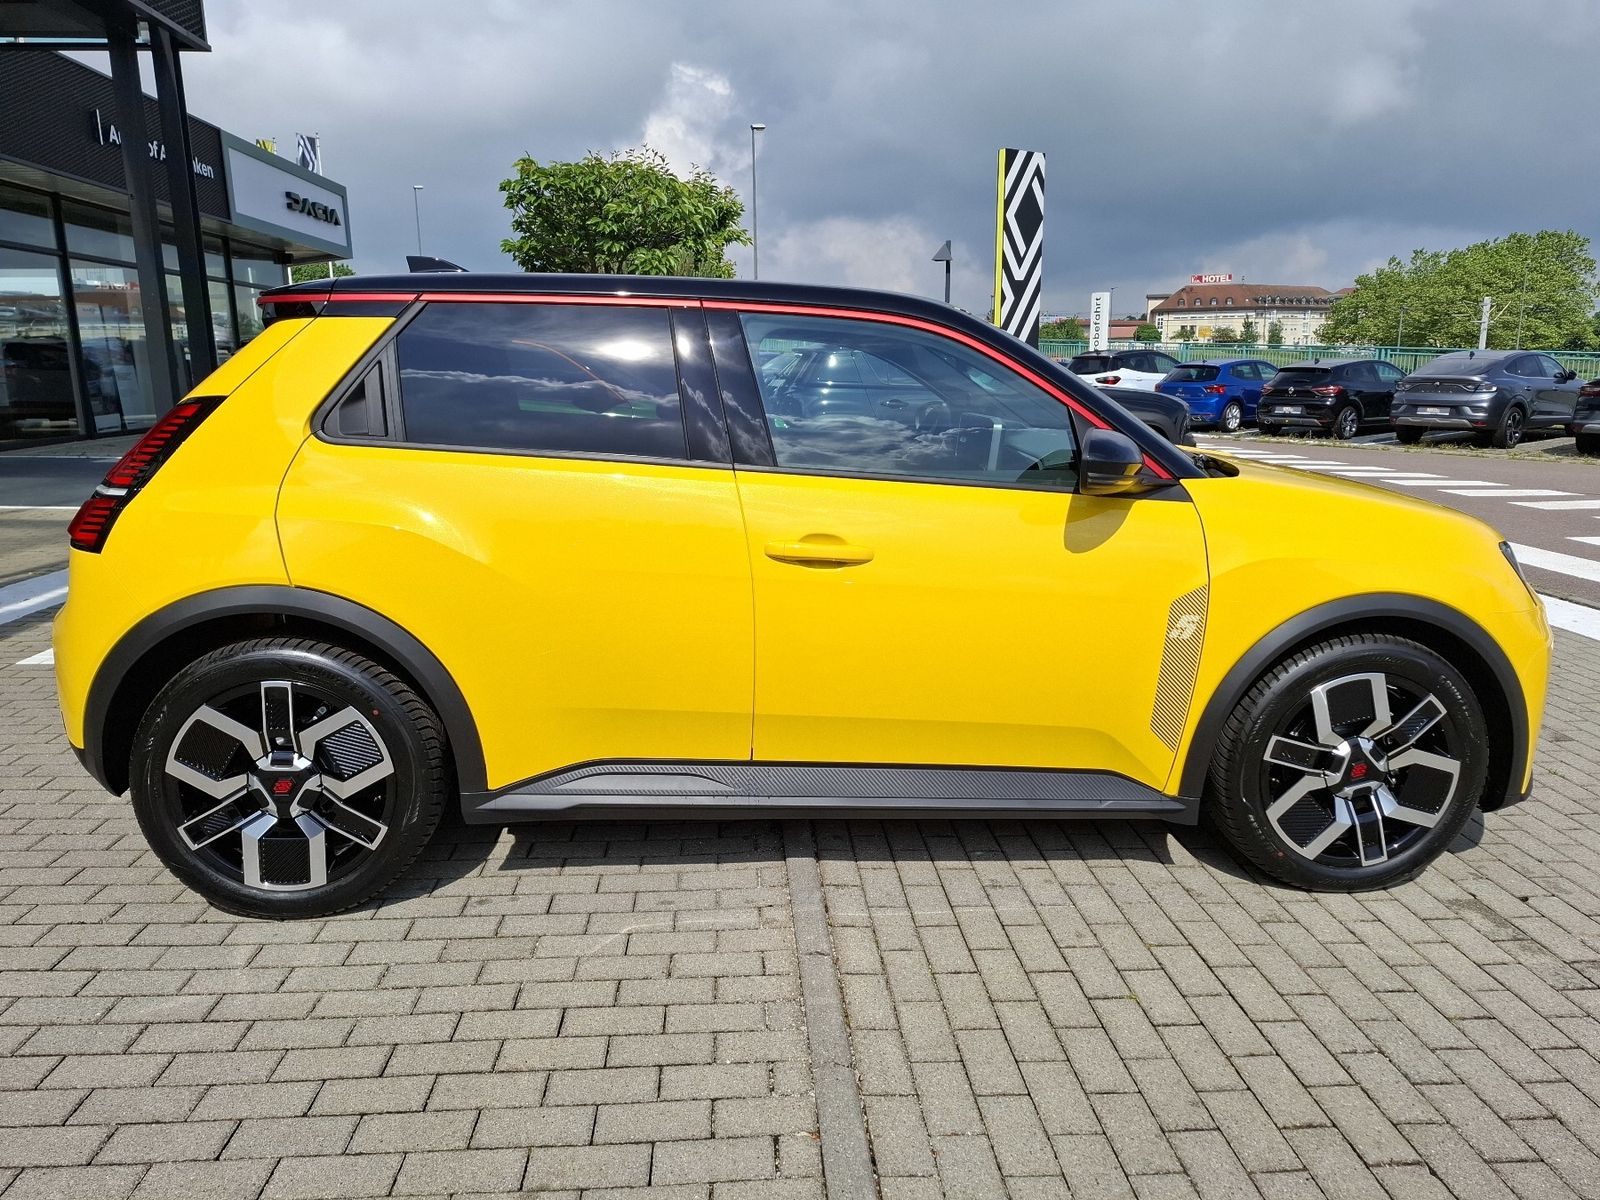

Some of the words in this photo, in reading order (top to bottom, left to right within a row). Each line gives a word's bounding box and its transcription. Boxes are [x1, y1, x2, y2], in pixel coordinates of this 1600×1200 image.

[285, 191, 341, 226] DACIA
[1202, 274, 1232, 283] HOTEL
[1093, 297, 1101, 351] robefahrt
